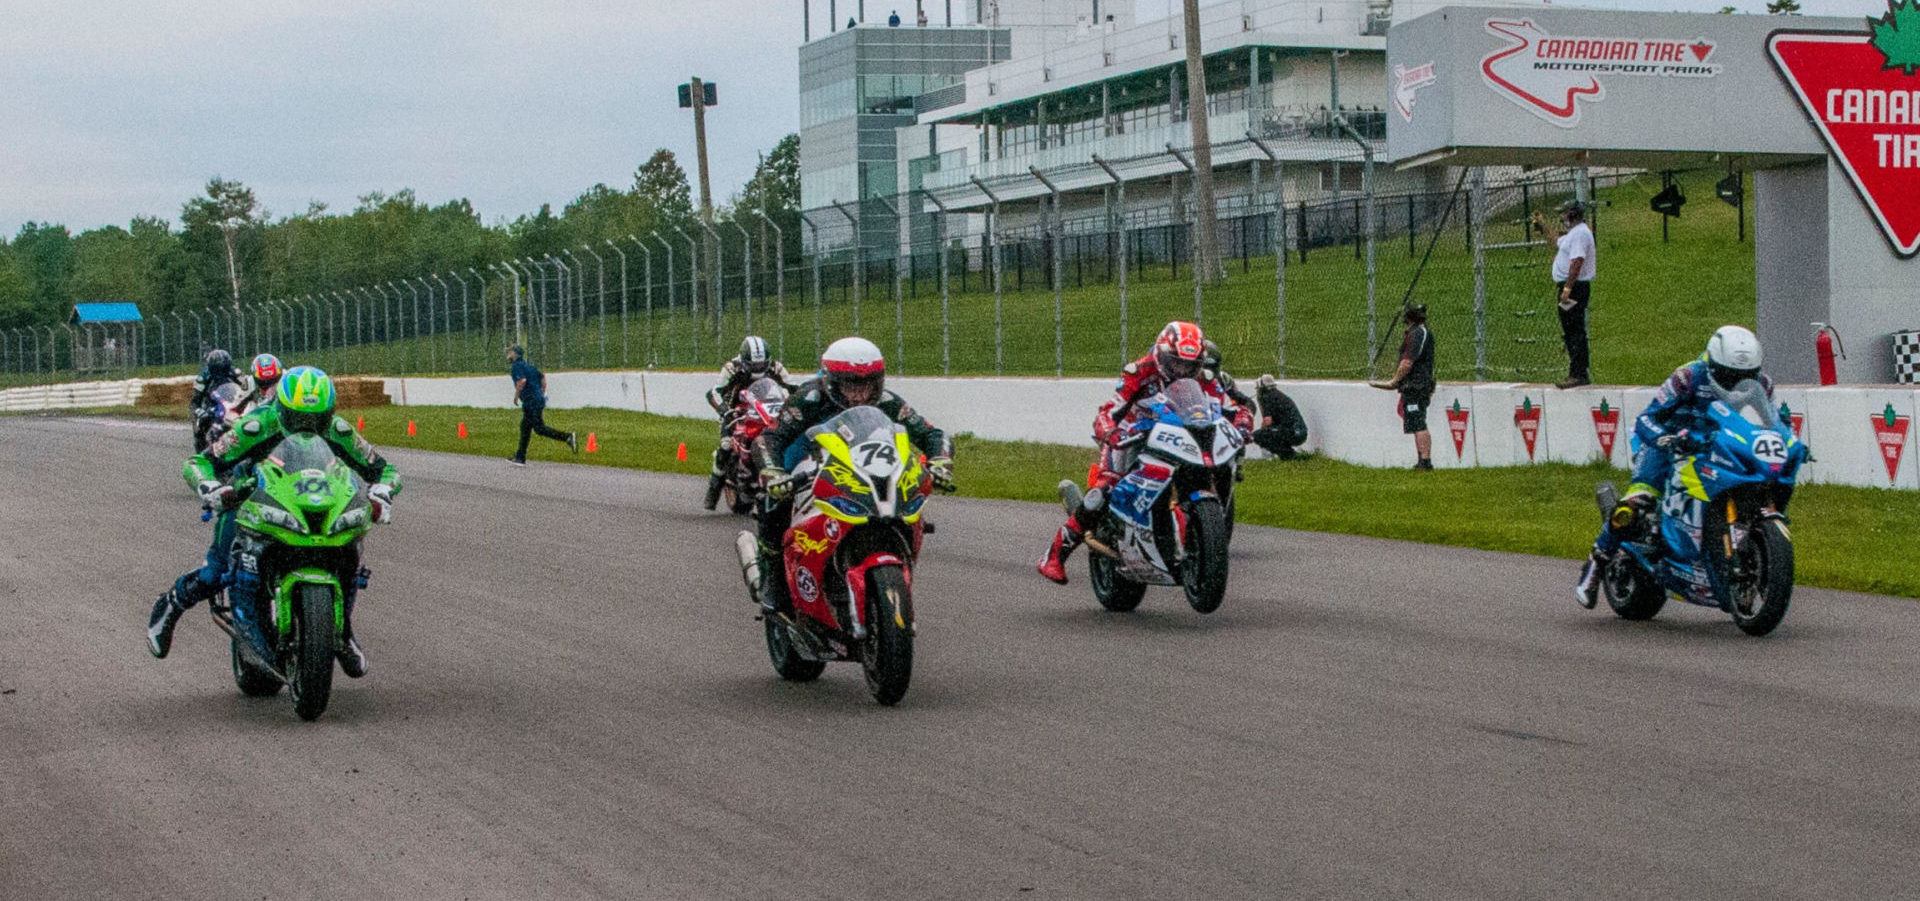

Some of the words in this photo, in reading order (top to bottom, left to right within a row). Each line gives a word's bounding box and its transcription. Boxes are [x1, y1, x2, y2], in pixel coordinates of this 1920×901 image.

[1536, 39, 1638, 60] CANADIAN
[1644, 42, 1686, 62] TIRE
[1533, 62, 1659, 73] MOTORSPORT
[1663, 65, 1713, 75] PARK
[1156, 431, 1183, 447] EFC
[859, 442, 897, 468] 74
[1754, 439, 1787, 460] 42
[293, 478, 334, 497] 101
